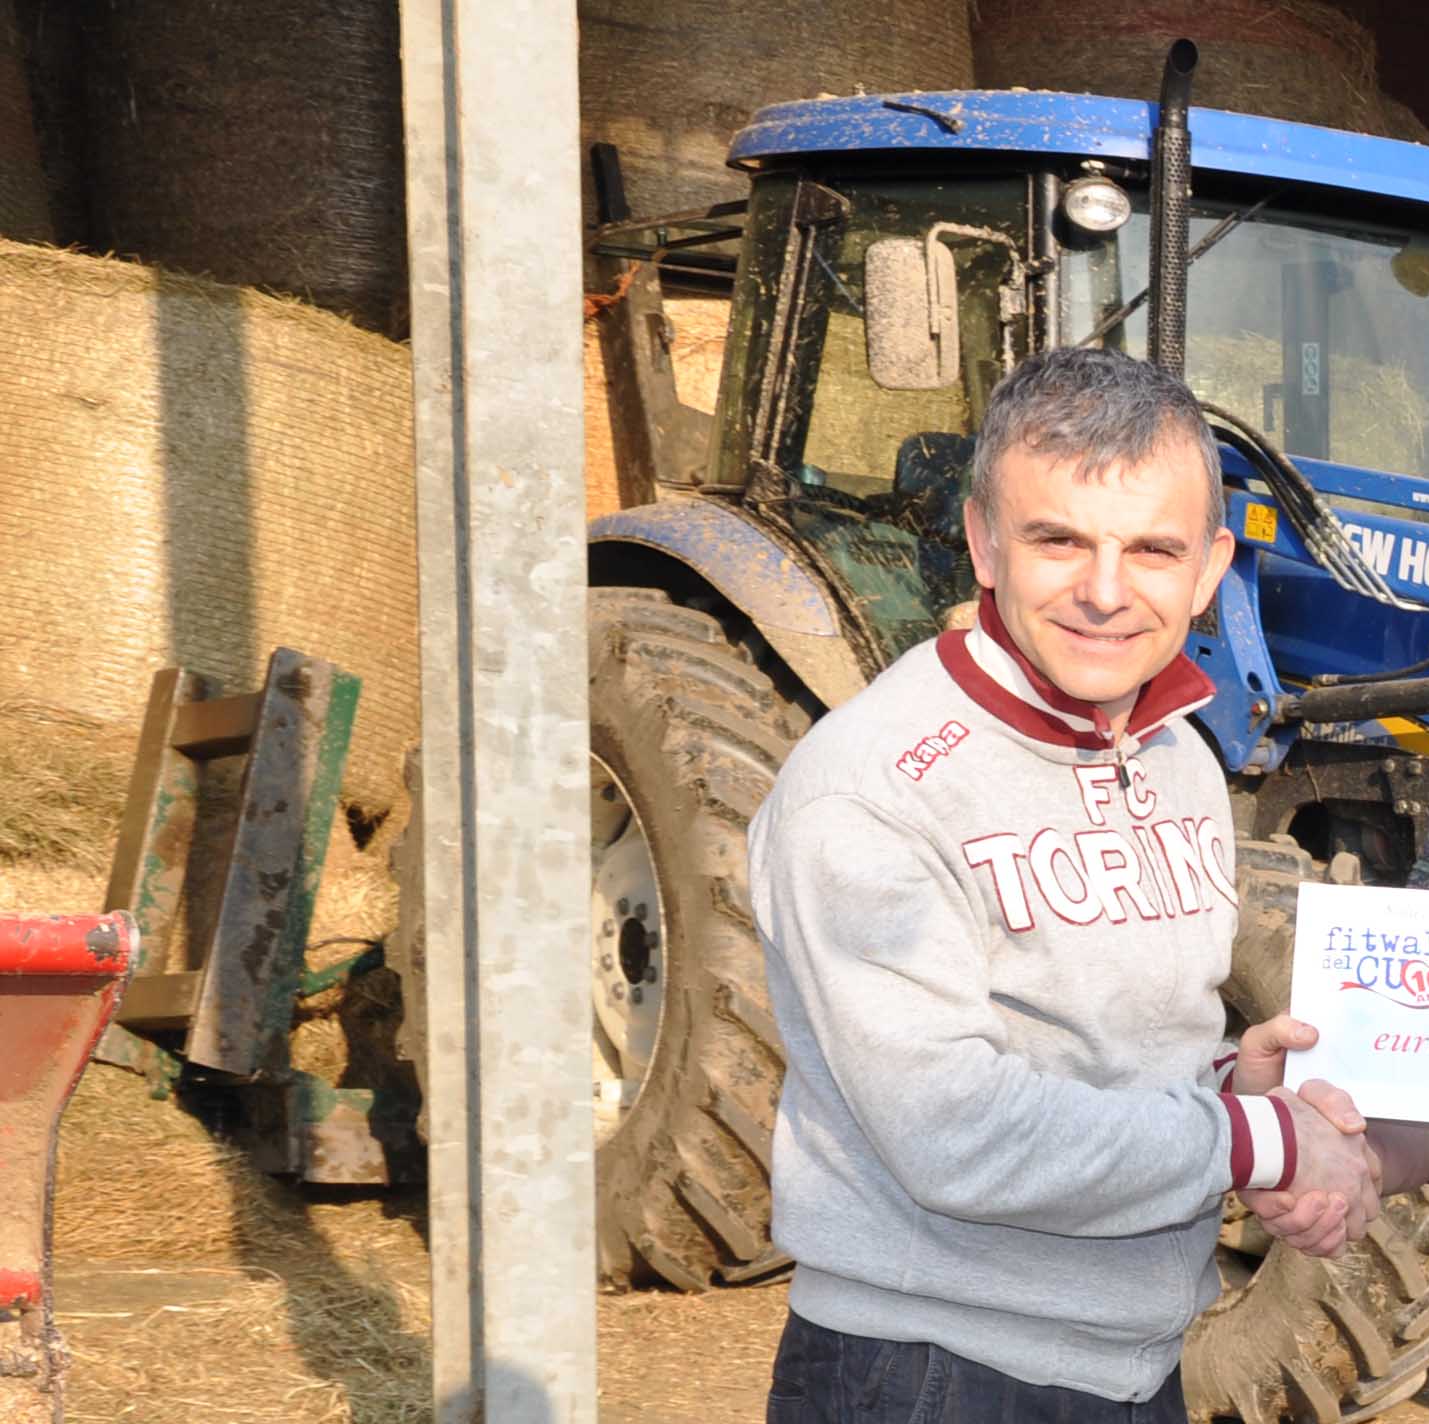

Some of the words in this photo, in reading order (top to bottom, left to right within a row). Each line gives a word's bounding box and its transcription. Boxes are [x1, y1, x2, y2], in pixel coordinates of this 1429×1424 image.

[1338, 520, 1396, 576] EW
[1073, 758, 1157, 826] FC
[1322, 954, 1353, 970] del
